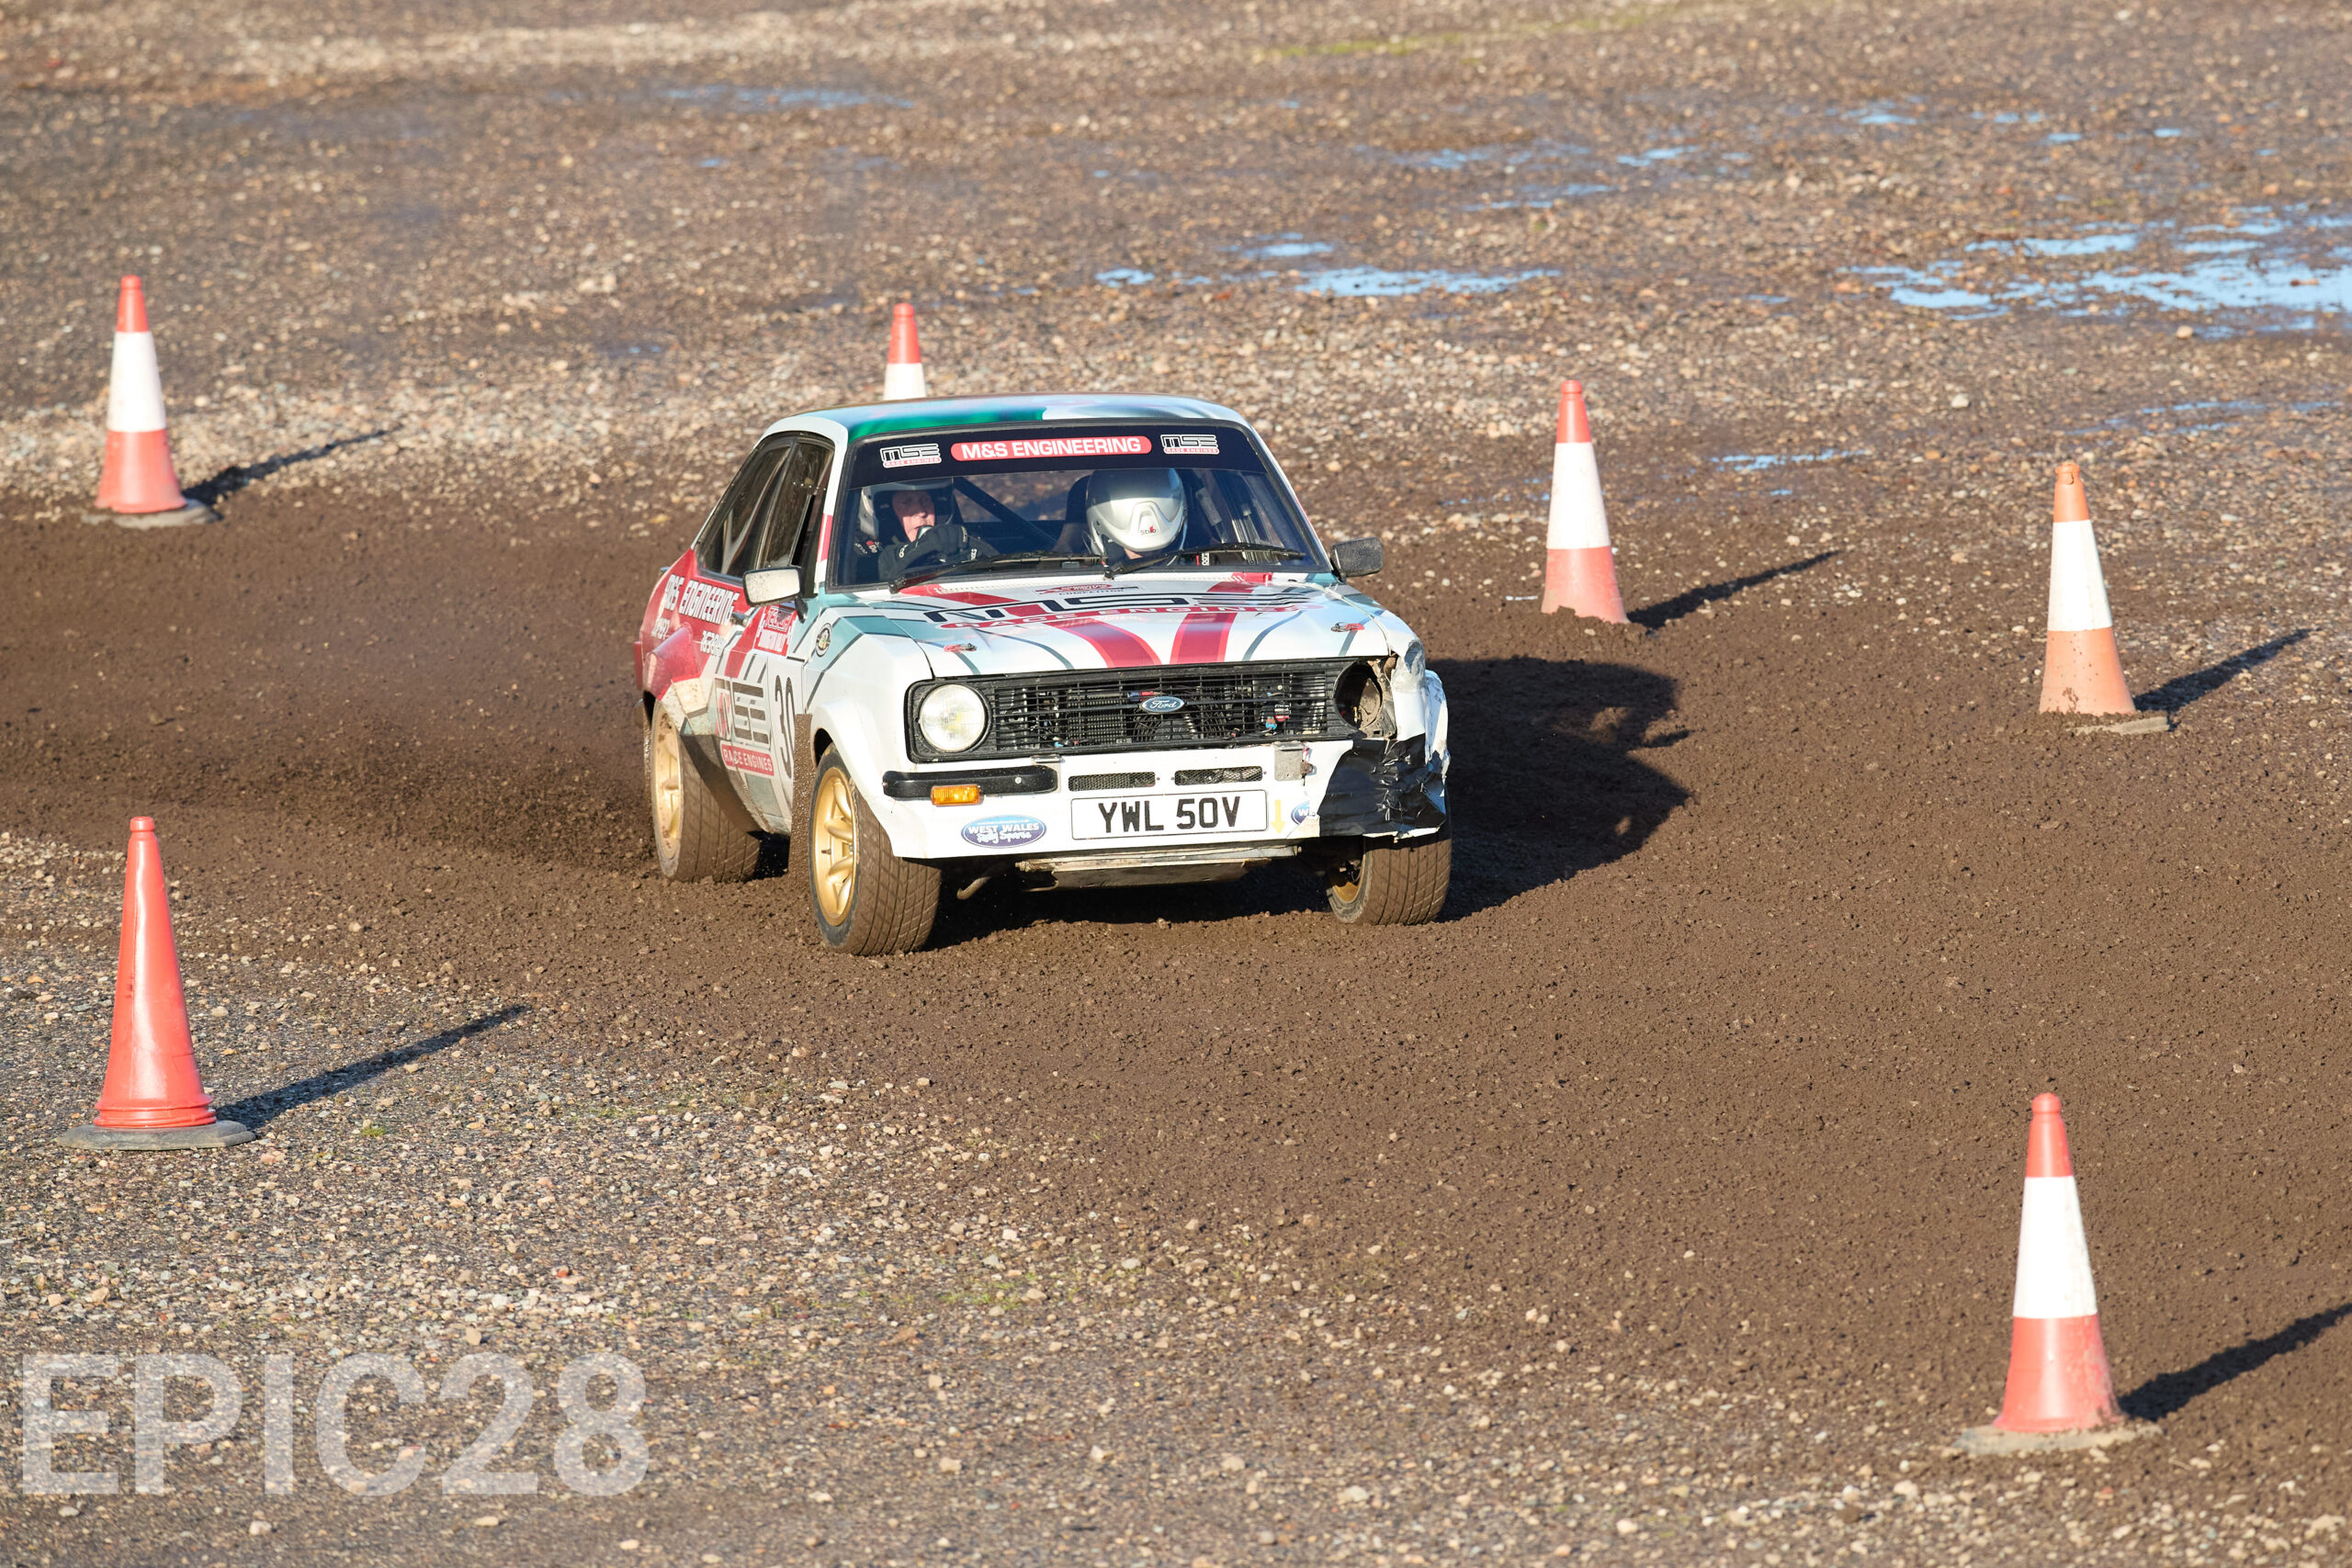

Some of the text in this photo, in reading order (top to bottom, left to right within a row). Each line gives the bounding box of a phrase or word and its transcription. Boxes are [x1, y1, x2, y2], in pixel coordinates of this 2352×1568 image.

[961, 437, 1141, 459] M&S ENGINEERING
[954, 613, 1079, 628] RACE
[1149, 700, 1177, 709] Ford
[722, 749, 773, 772] RACE ENGINES
[1098, 796, 1241, 833] YWL 50V
[967, 822, 1040, 834] WEST WALES
